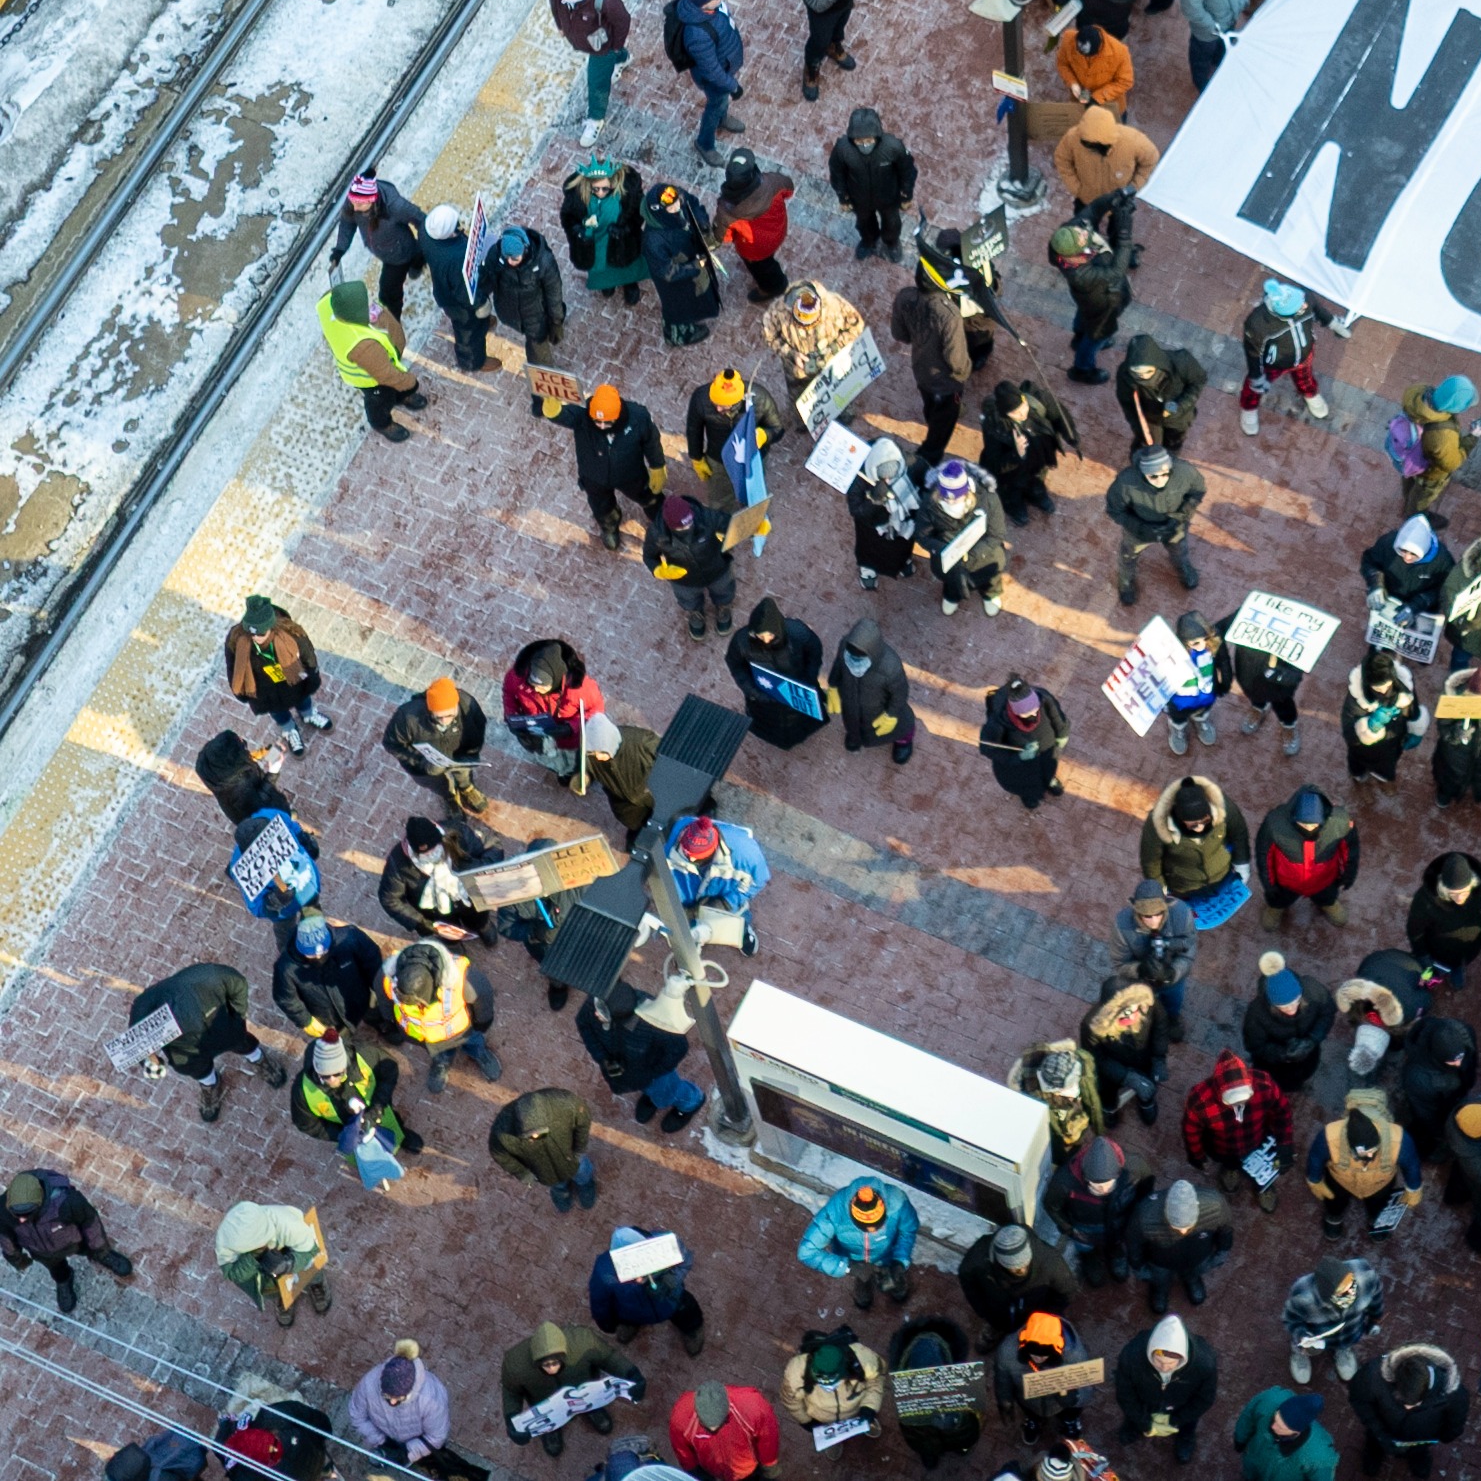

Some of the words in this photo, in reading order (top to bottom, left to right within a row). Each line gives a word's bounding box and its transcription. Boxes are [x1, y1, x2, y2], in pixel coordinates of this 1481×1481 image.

[533, 380, 584, 404] KILLS
[535, 370, 574, 390] ICE
[1243, 607, 1311, 642] ICE
[1262, 596, 1293, 617] like
[1296, 611, 1324, 631] my
[1230, 621, 1305, 662] CRUSHED
[1374, 622, 1411, 638] JUSTICE
[237, 829, 292, 885] VOTE
[552, 844, 590, 862] ICE
[559, 861, 607, 882] READ!
